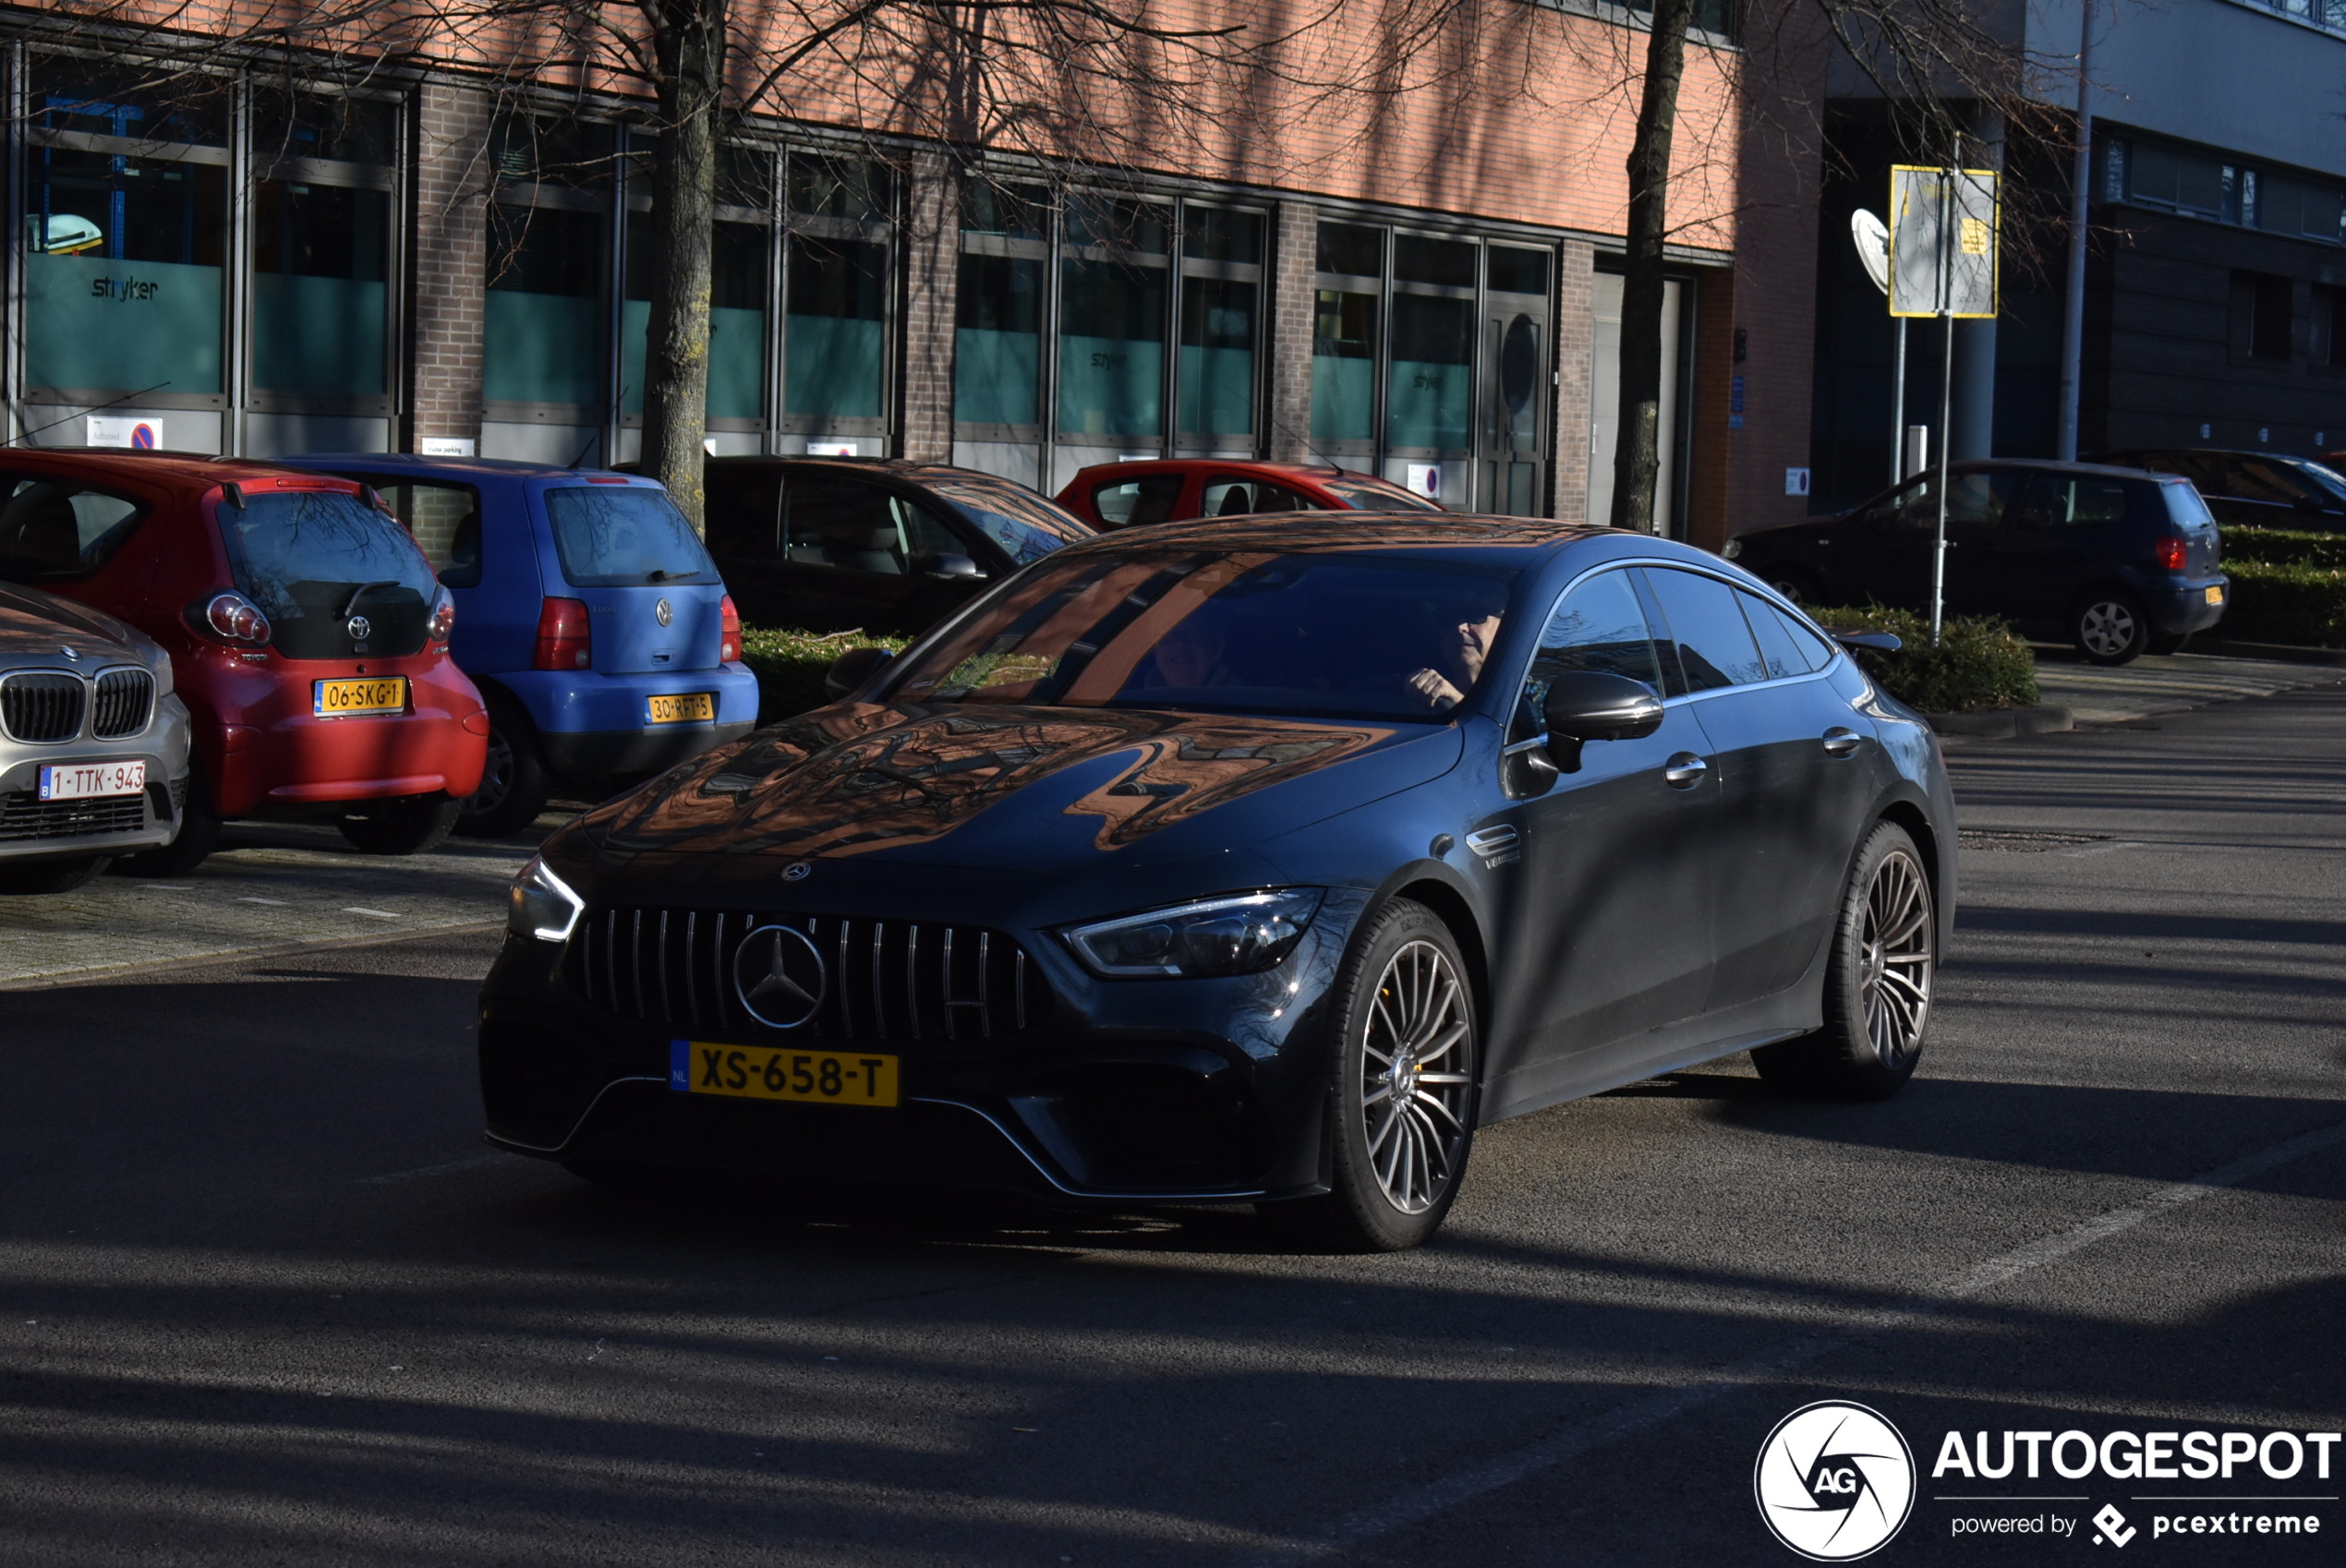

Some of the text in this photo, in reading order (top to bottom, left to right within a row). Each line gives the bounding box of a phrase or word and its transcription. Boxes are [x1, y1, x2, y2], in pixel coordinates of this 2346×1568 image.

[91, 274, 158, 303] stryker
[329, 683, 397, 707] 06-SKG-1
[654, 696, 708, 719] 30-RFT-5
[42, 786, 49, 796] B
[672, 1048, 884, 1098] NL XS-658-T
